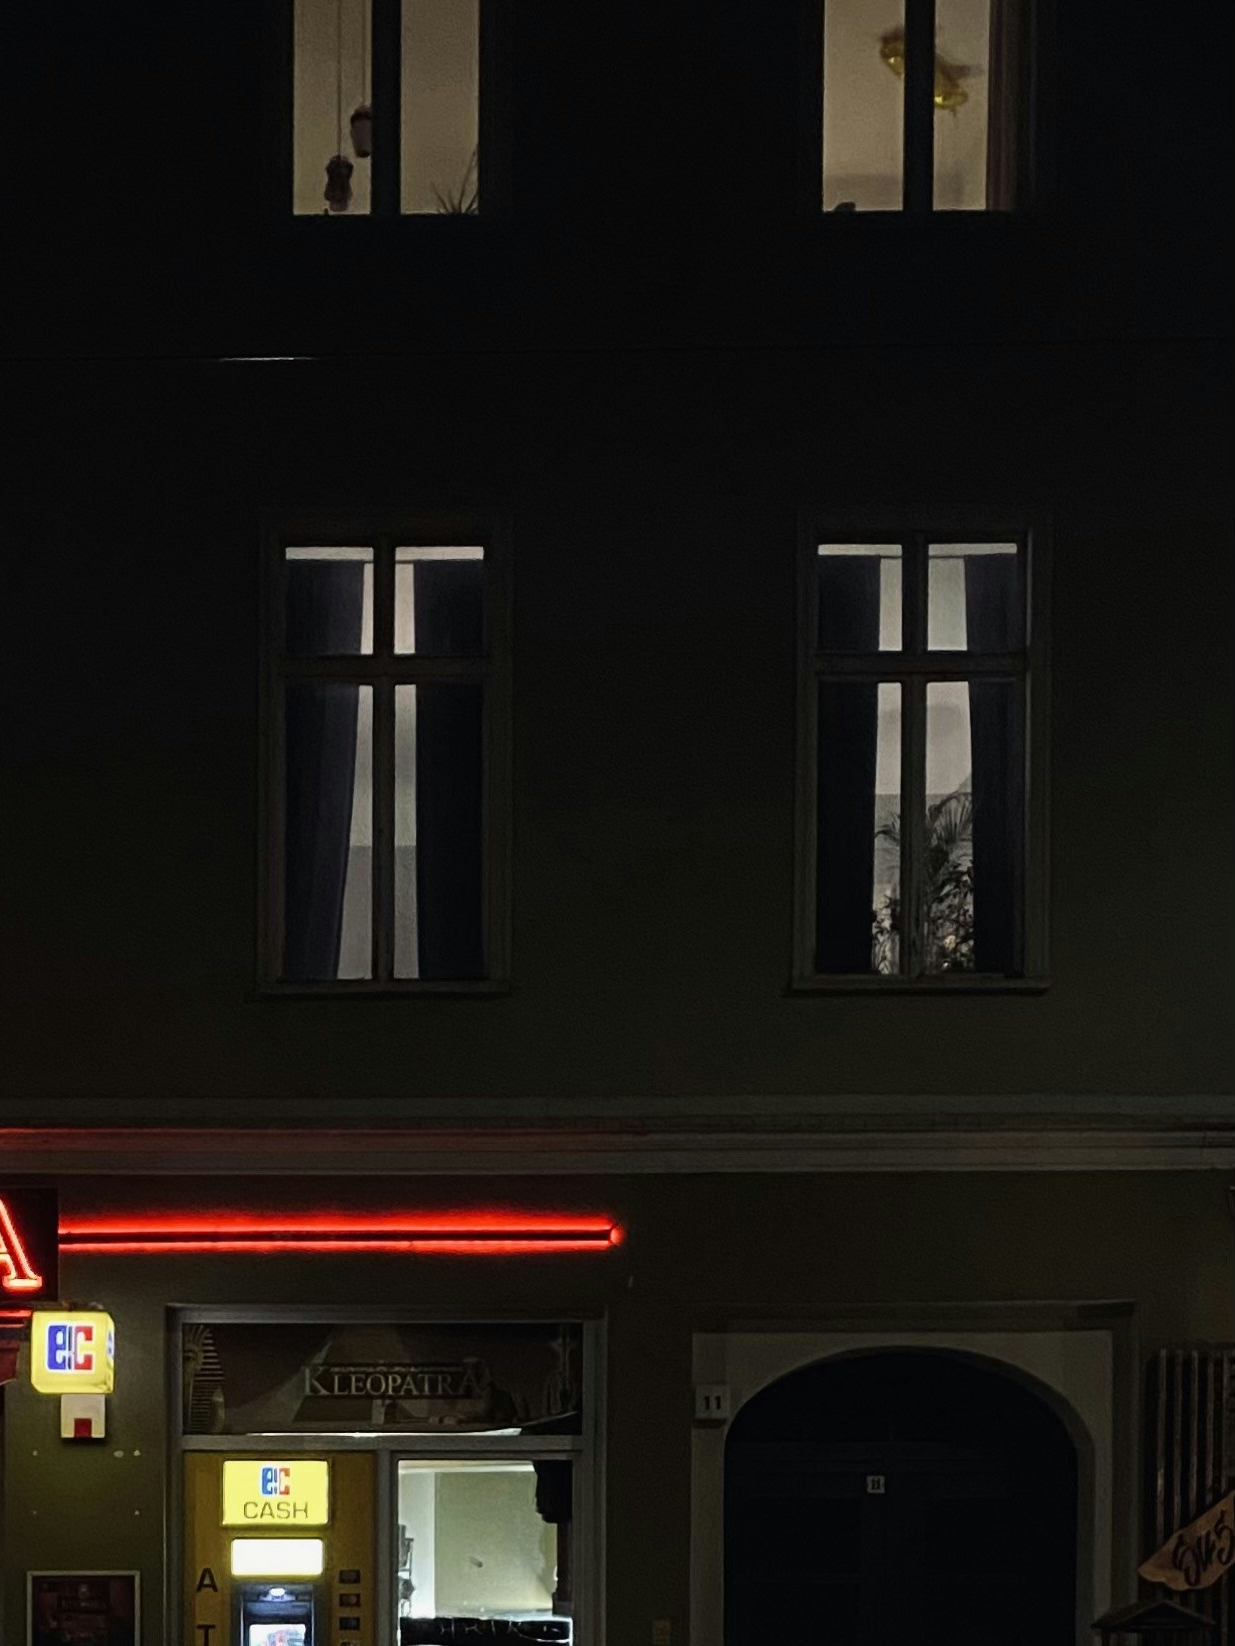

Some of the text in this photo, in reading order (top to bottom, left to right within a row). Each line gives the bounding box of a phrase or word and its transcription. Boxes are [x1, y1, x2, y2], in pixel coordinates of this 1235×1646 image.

[304, 1357, 493, 1397] KLEOPATRA
[704, 1395, 721, 1410] 11
[243, 1501, 309, 1519] CASH
